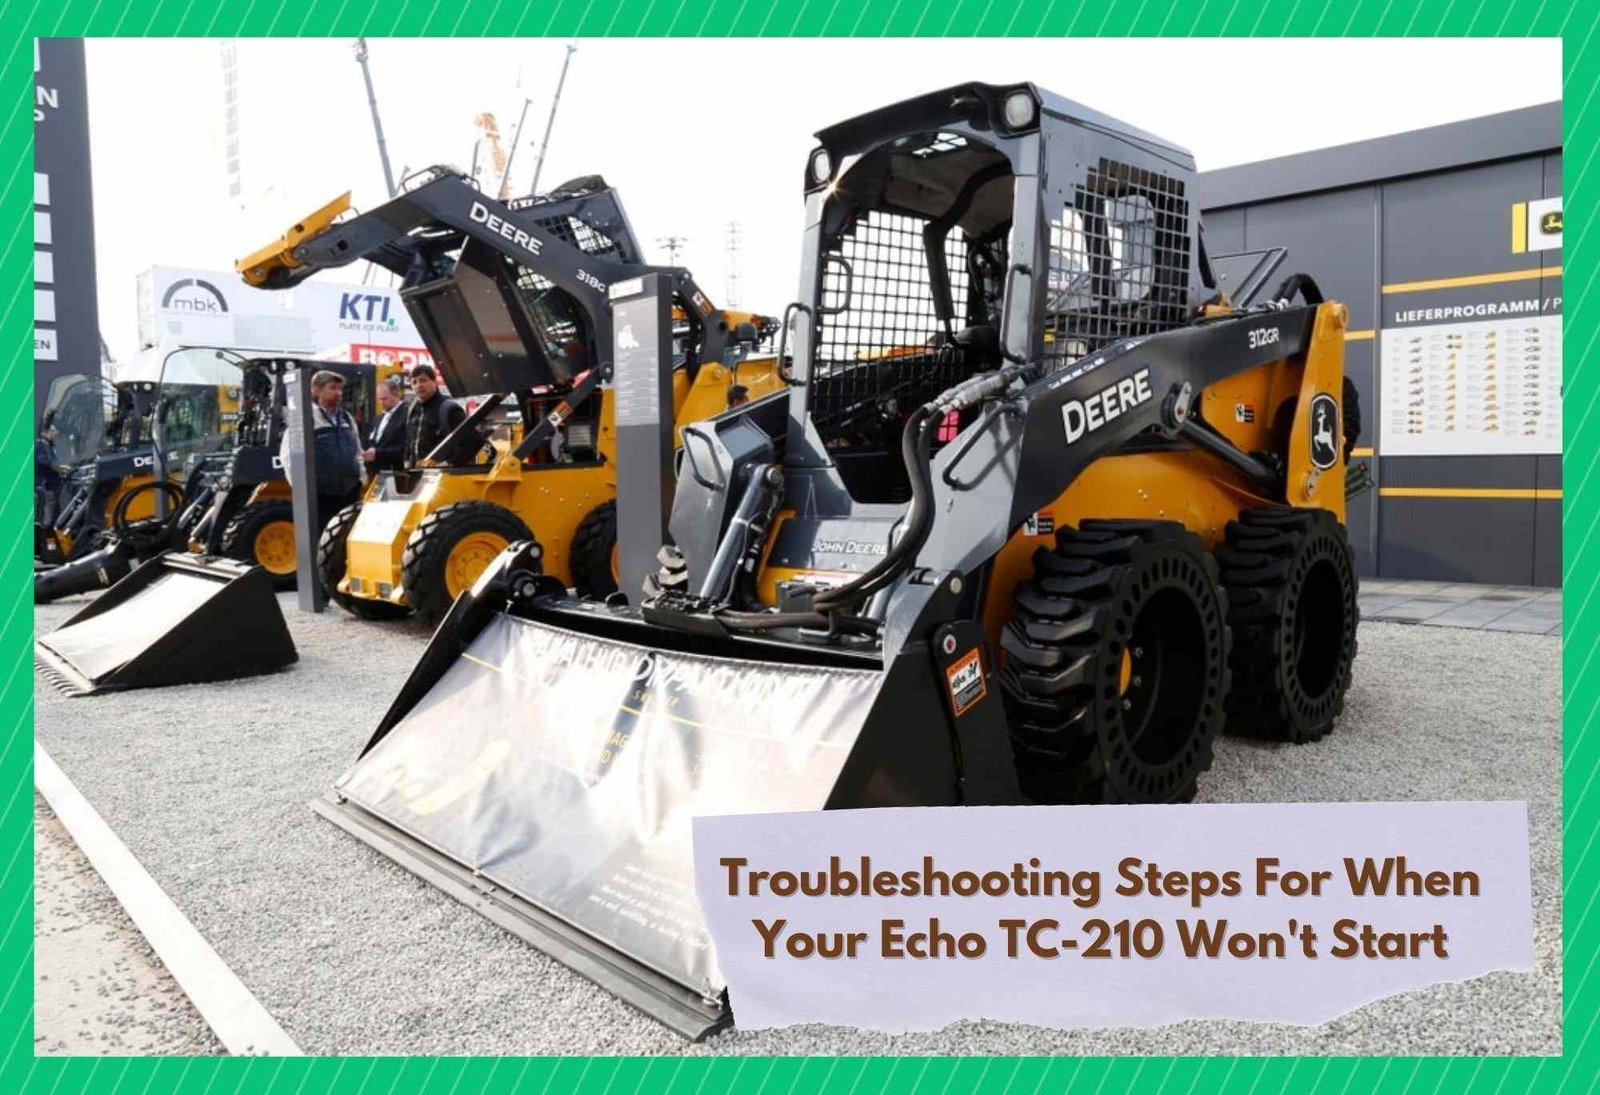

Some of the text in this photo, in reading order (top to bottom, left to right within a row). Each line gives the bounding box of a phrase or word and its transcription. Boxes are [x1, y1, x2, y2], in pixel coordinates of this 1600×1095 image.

[469, 201, 544, 256] DEERE
[174, 297, 217, 312] mbk
[1395, 299, 1539, 323] LIEFERPROGRAMM
[1248, 327, 1280, 349] 312GR
[1061, 368, 1152, 445] DEERE
